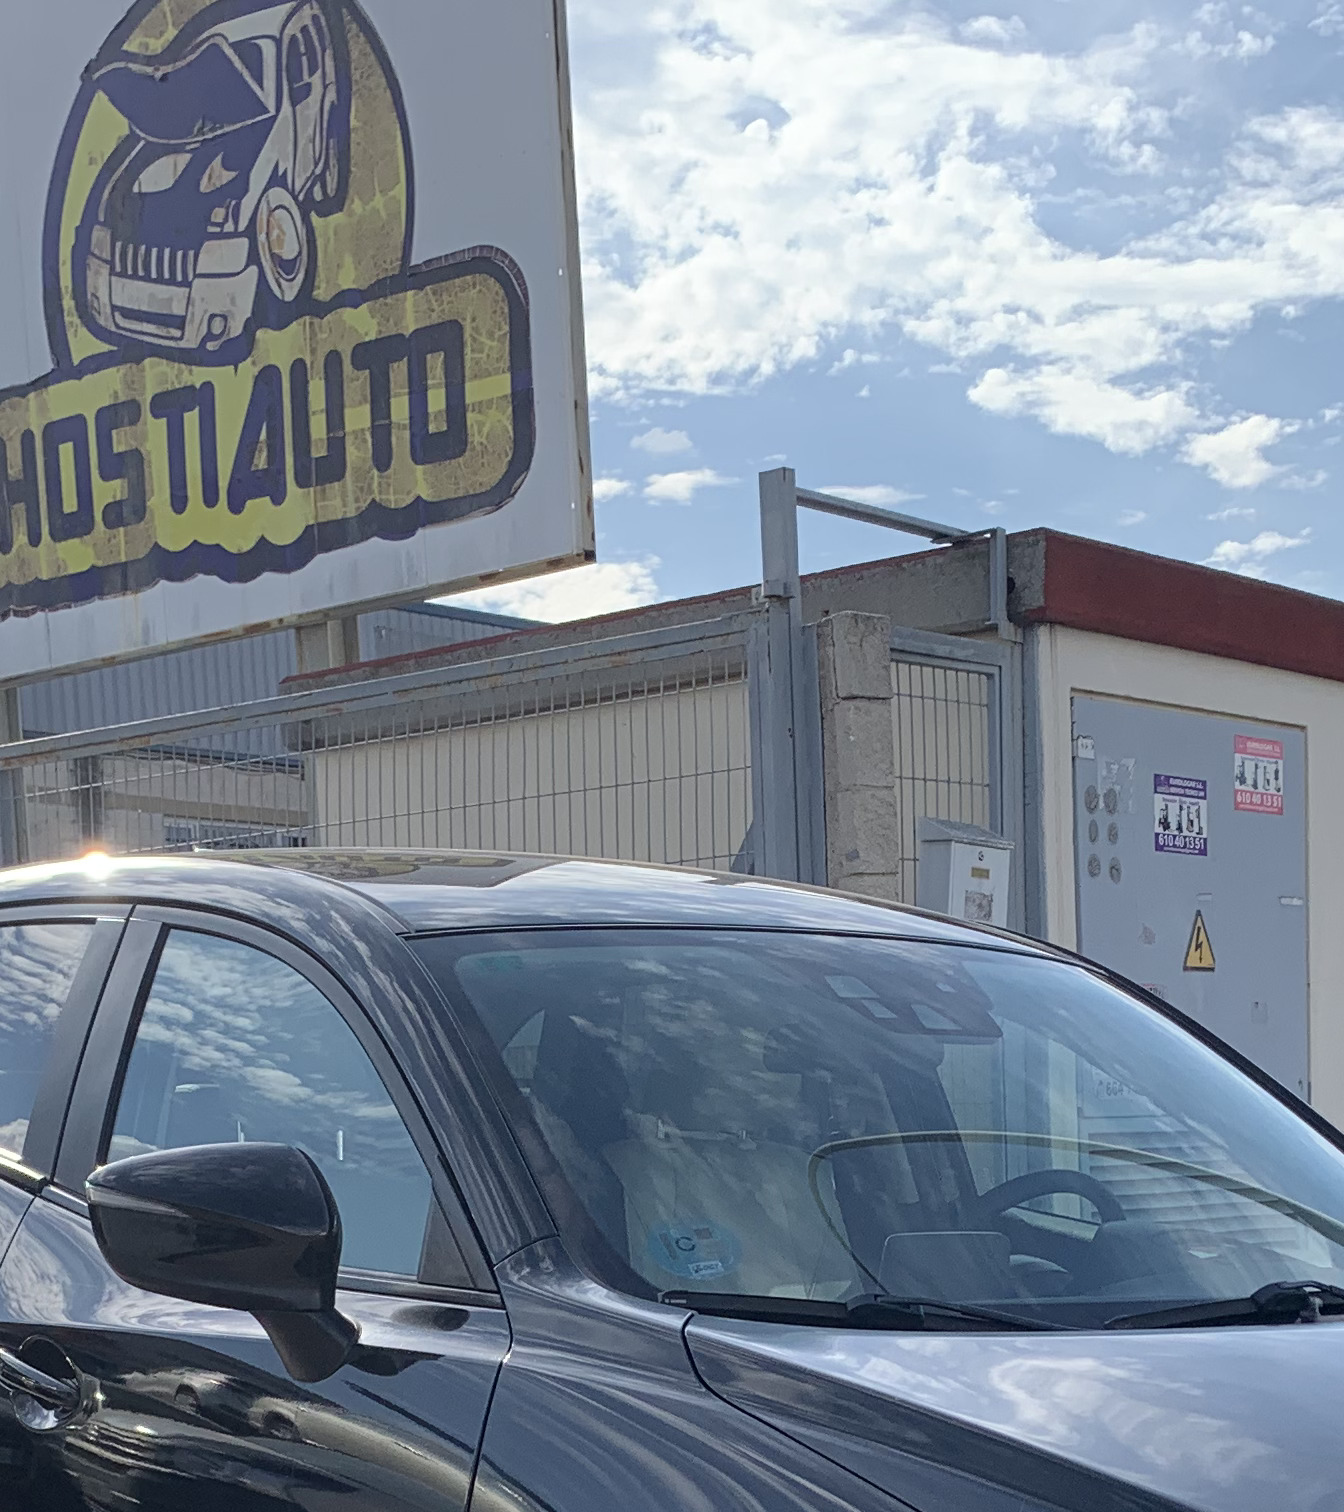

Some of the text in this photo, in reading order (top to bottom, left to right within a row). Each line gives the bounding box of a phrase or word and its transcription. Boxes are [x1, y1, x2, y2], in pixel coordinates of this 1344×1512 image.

[1158, 834, 1174, 847] 610
[1174, 835, 1184, 848] 40
[1185, 837, 1194, 849] 13
[1194, 838, 1204, 850] 51
